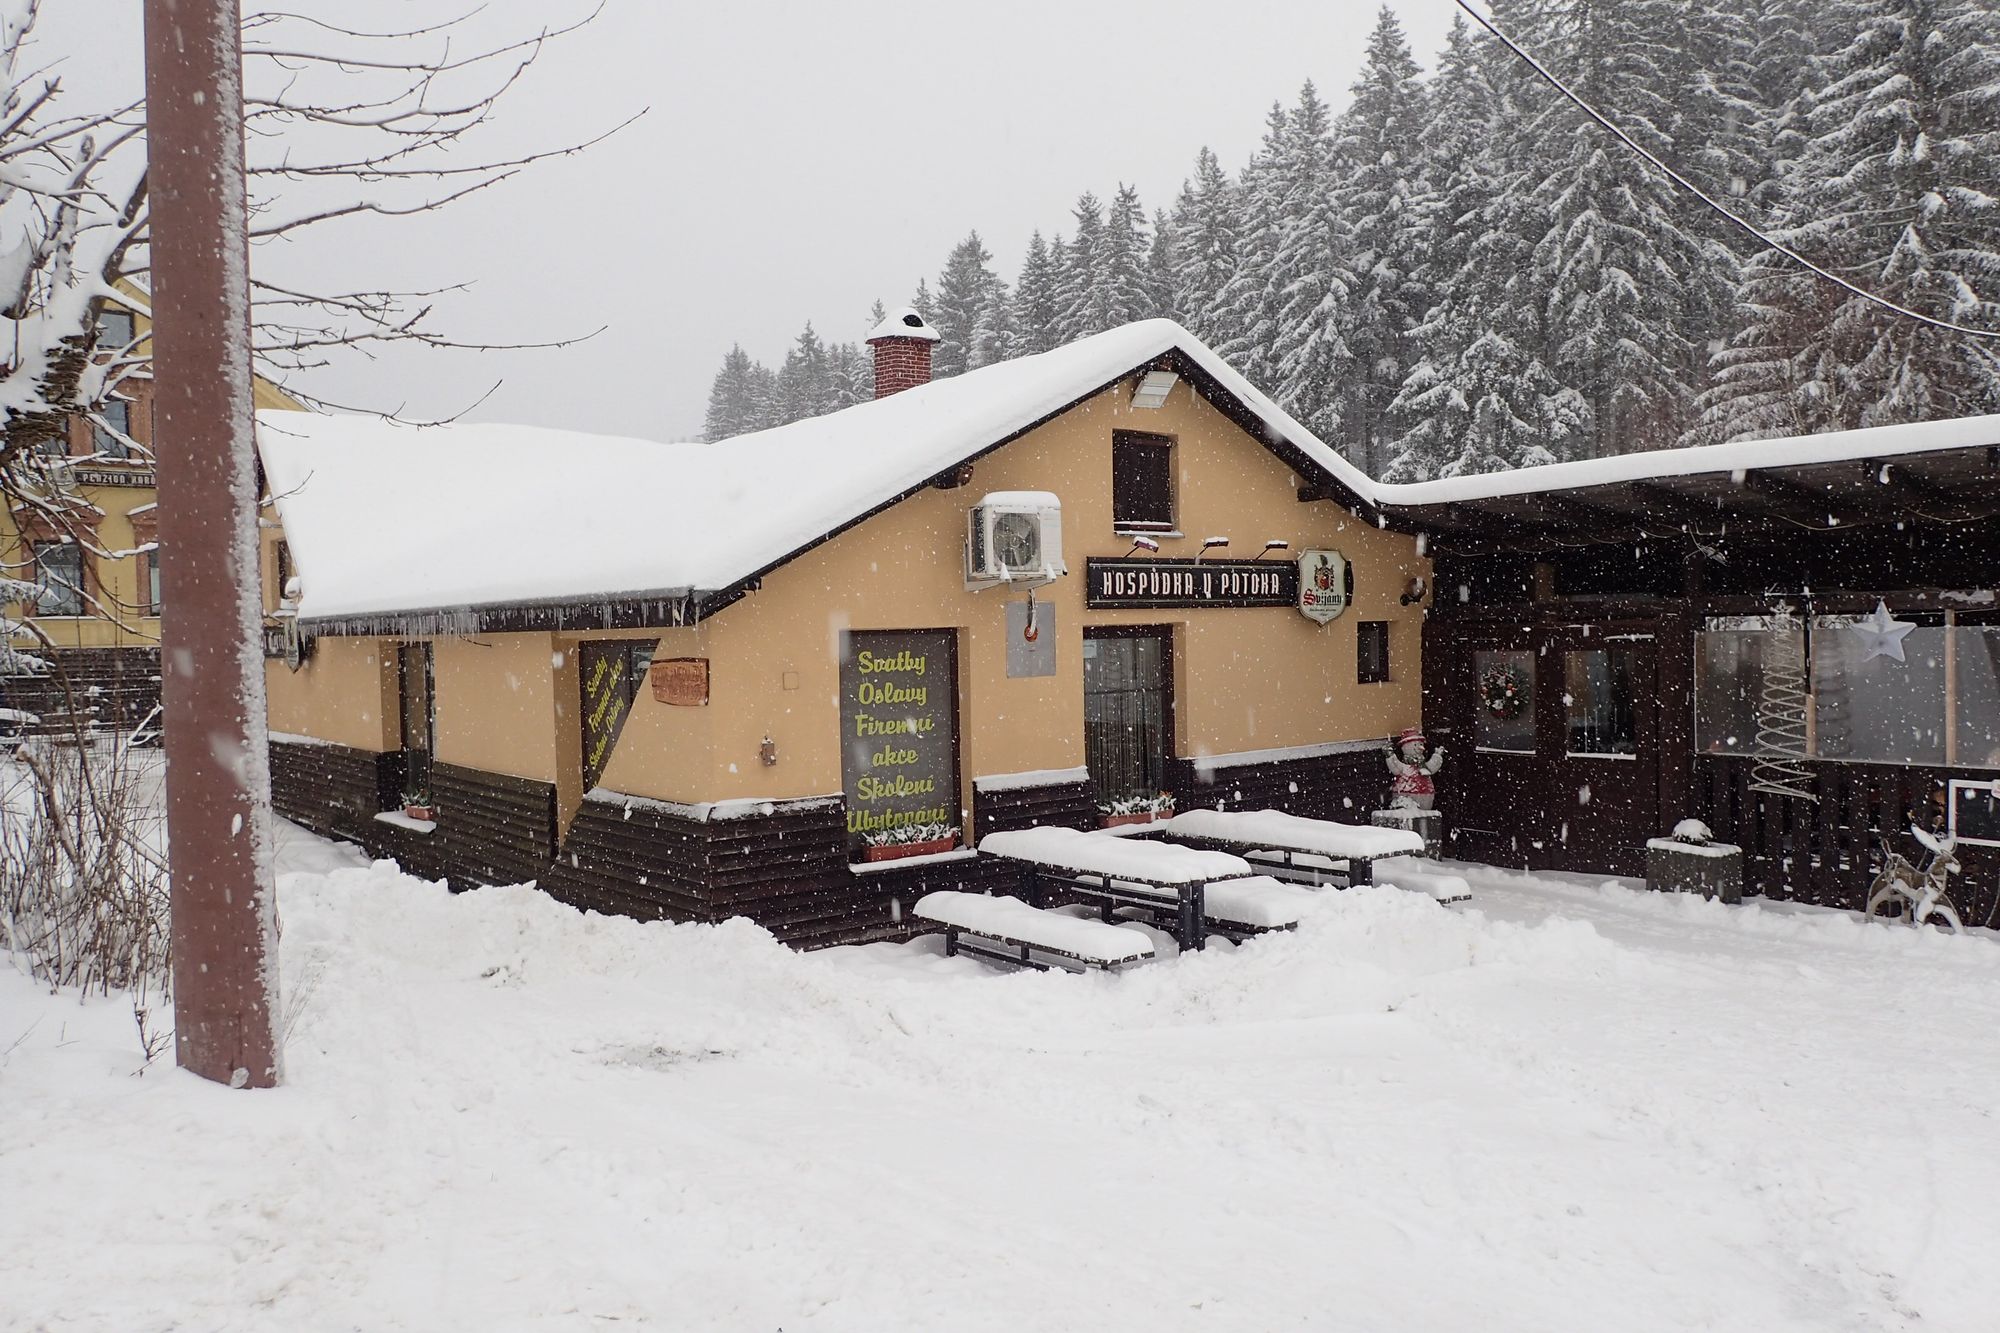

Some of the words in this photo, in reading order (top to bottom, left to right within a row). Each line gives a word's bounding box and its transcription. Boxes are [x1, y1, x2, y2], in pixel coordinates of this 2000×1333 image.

[82, 473, 125, 484] PENZION
[1203, 573, 1211, 596] U
[1221, 573, 1279, 595] POTOKA
[1303, 588, 1342, 606] Svijany
[858, 651, 926, 676] Svatby
[858, 682, 927, 706] Oslavy
[854, 714, 934, 736] Firemní
[872, 745, 919, 766] akce
[857, 772, 935, 800] Školení
